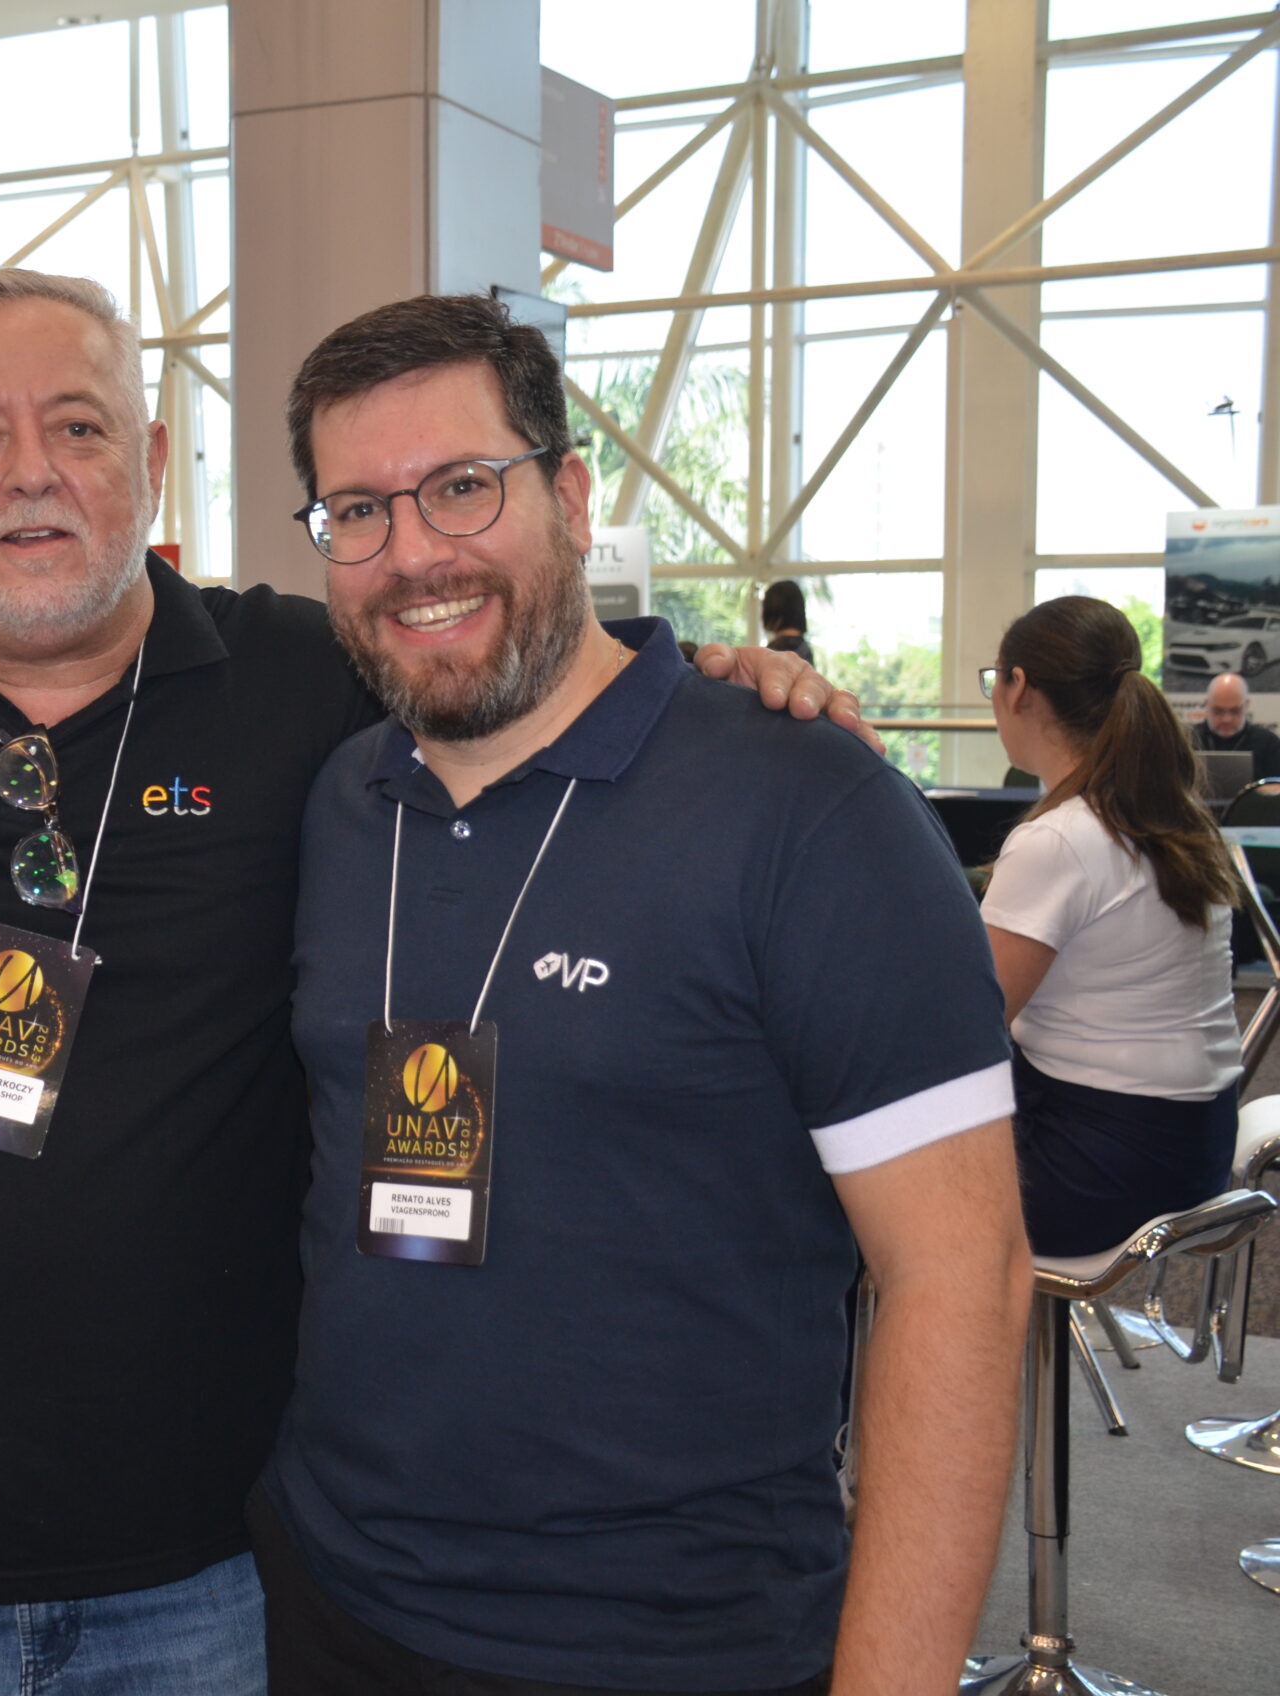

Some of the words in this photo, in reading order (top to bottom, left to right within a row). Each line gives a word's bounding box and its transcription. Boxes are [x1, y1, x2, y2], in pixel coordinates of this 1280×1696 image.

[143, 776, 211, 816] ets
[31, 1026, 49, 1063] 2023
[0, 1090, 23, 1102] SHOP
[387, 1113, 459, 1140] UNAV
[386, 1138, 457, 1157] AWARDS
[459, 1119, 471, 1159] 2023
[391, 1193, 424, 1204] RENATO
[426, 1196, 452, 1206] ALVES
[391, 1205, 450, 1218] VIAGENSPROMO
